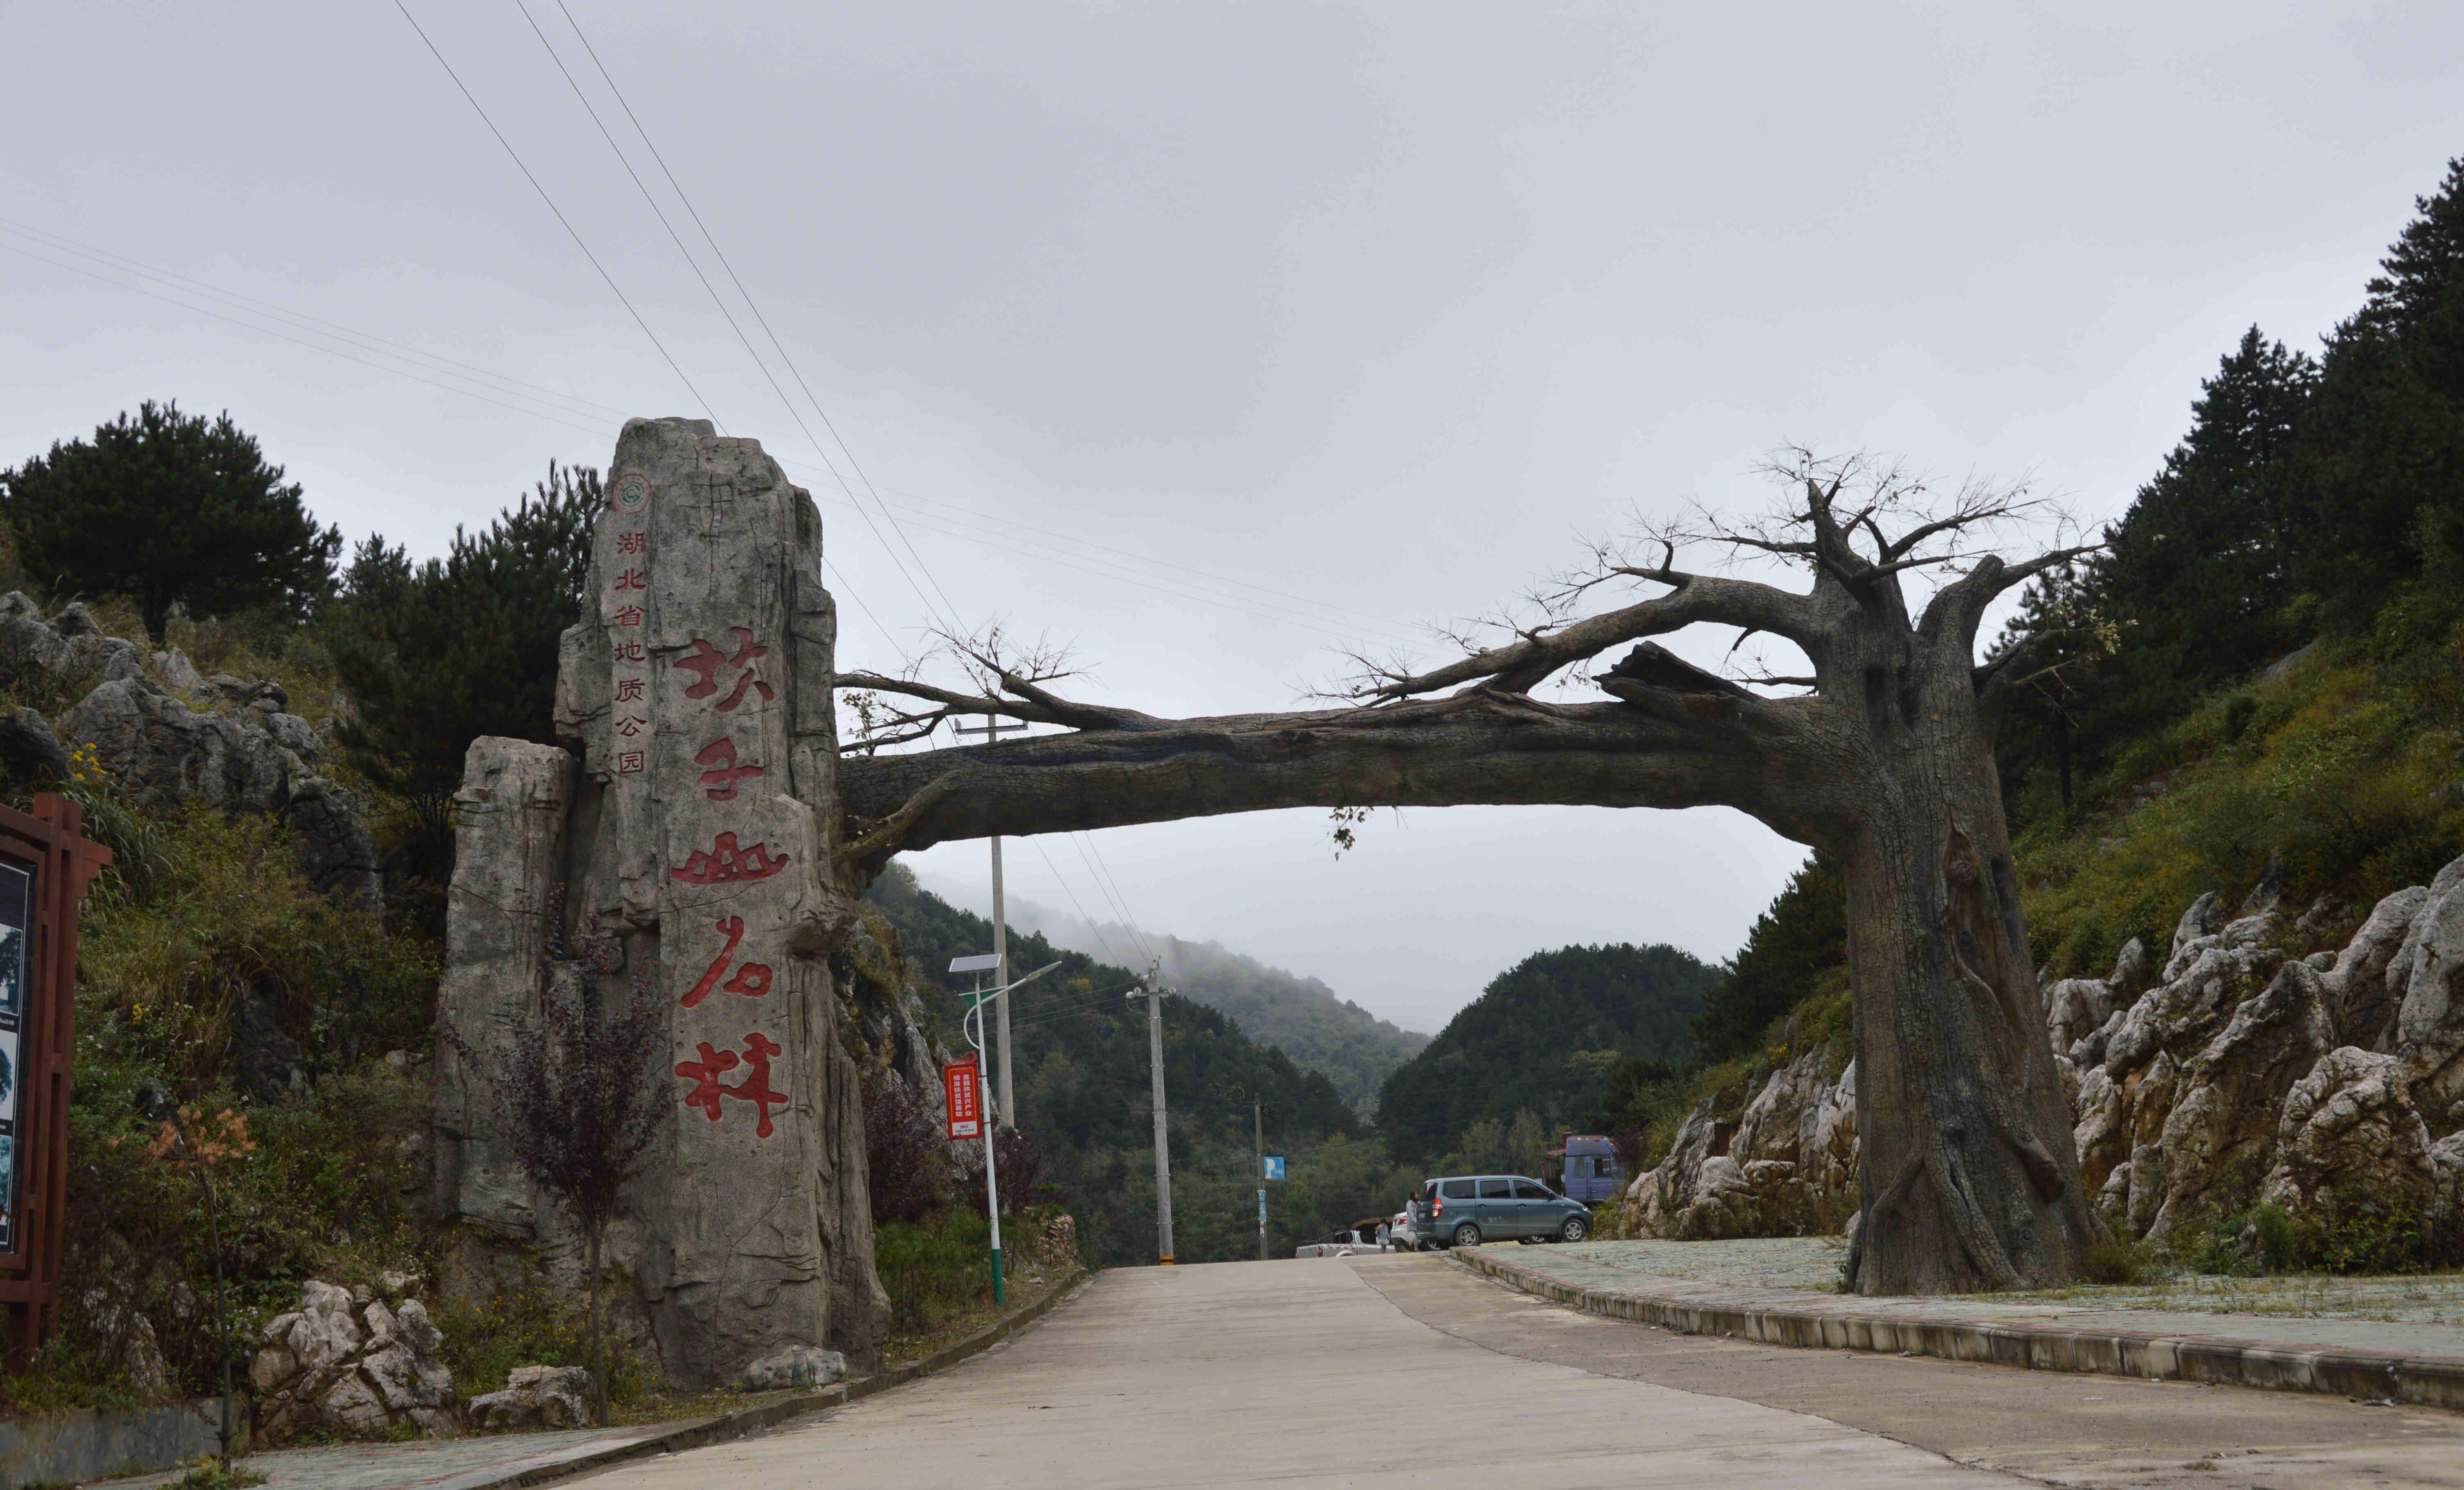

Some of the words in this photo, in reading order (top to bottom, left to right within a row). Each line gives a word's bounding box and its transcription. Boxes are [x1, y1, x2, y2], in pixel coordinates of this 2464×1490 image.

[614, 532, 647, 775] 湖北省地质公园
[671, 626, 790, 1139] 坎子山石林
[963, 1074, 973, 1116] 金融扶贫兴产业
